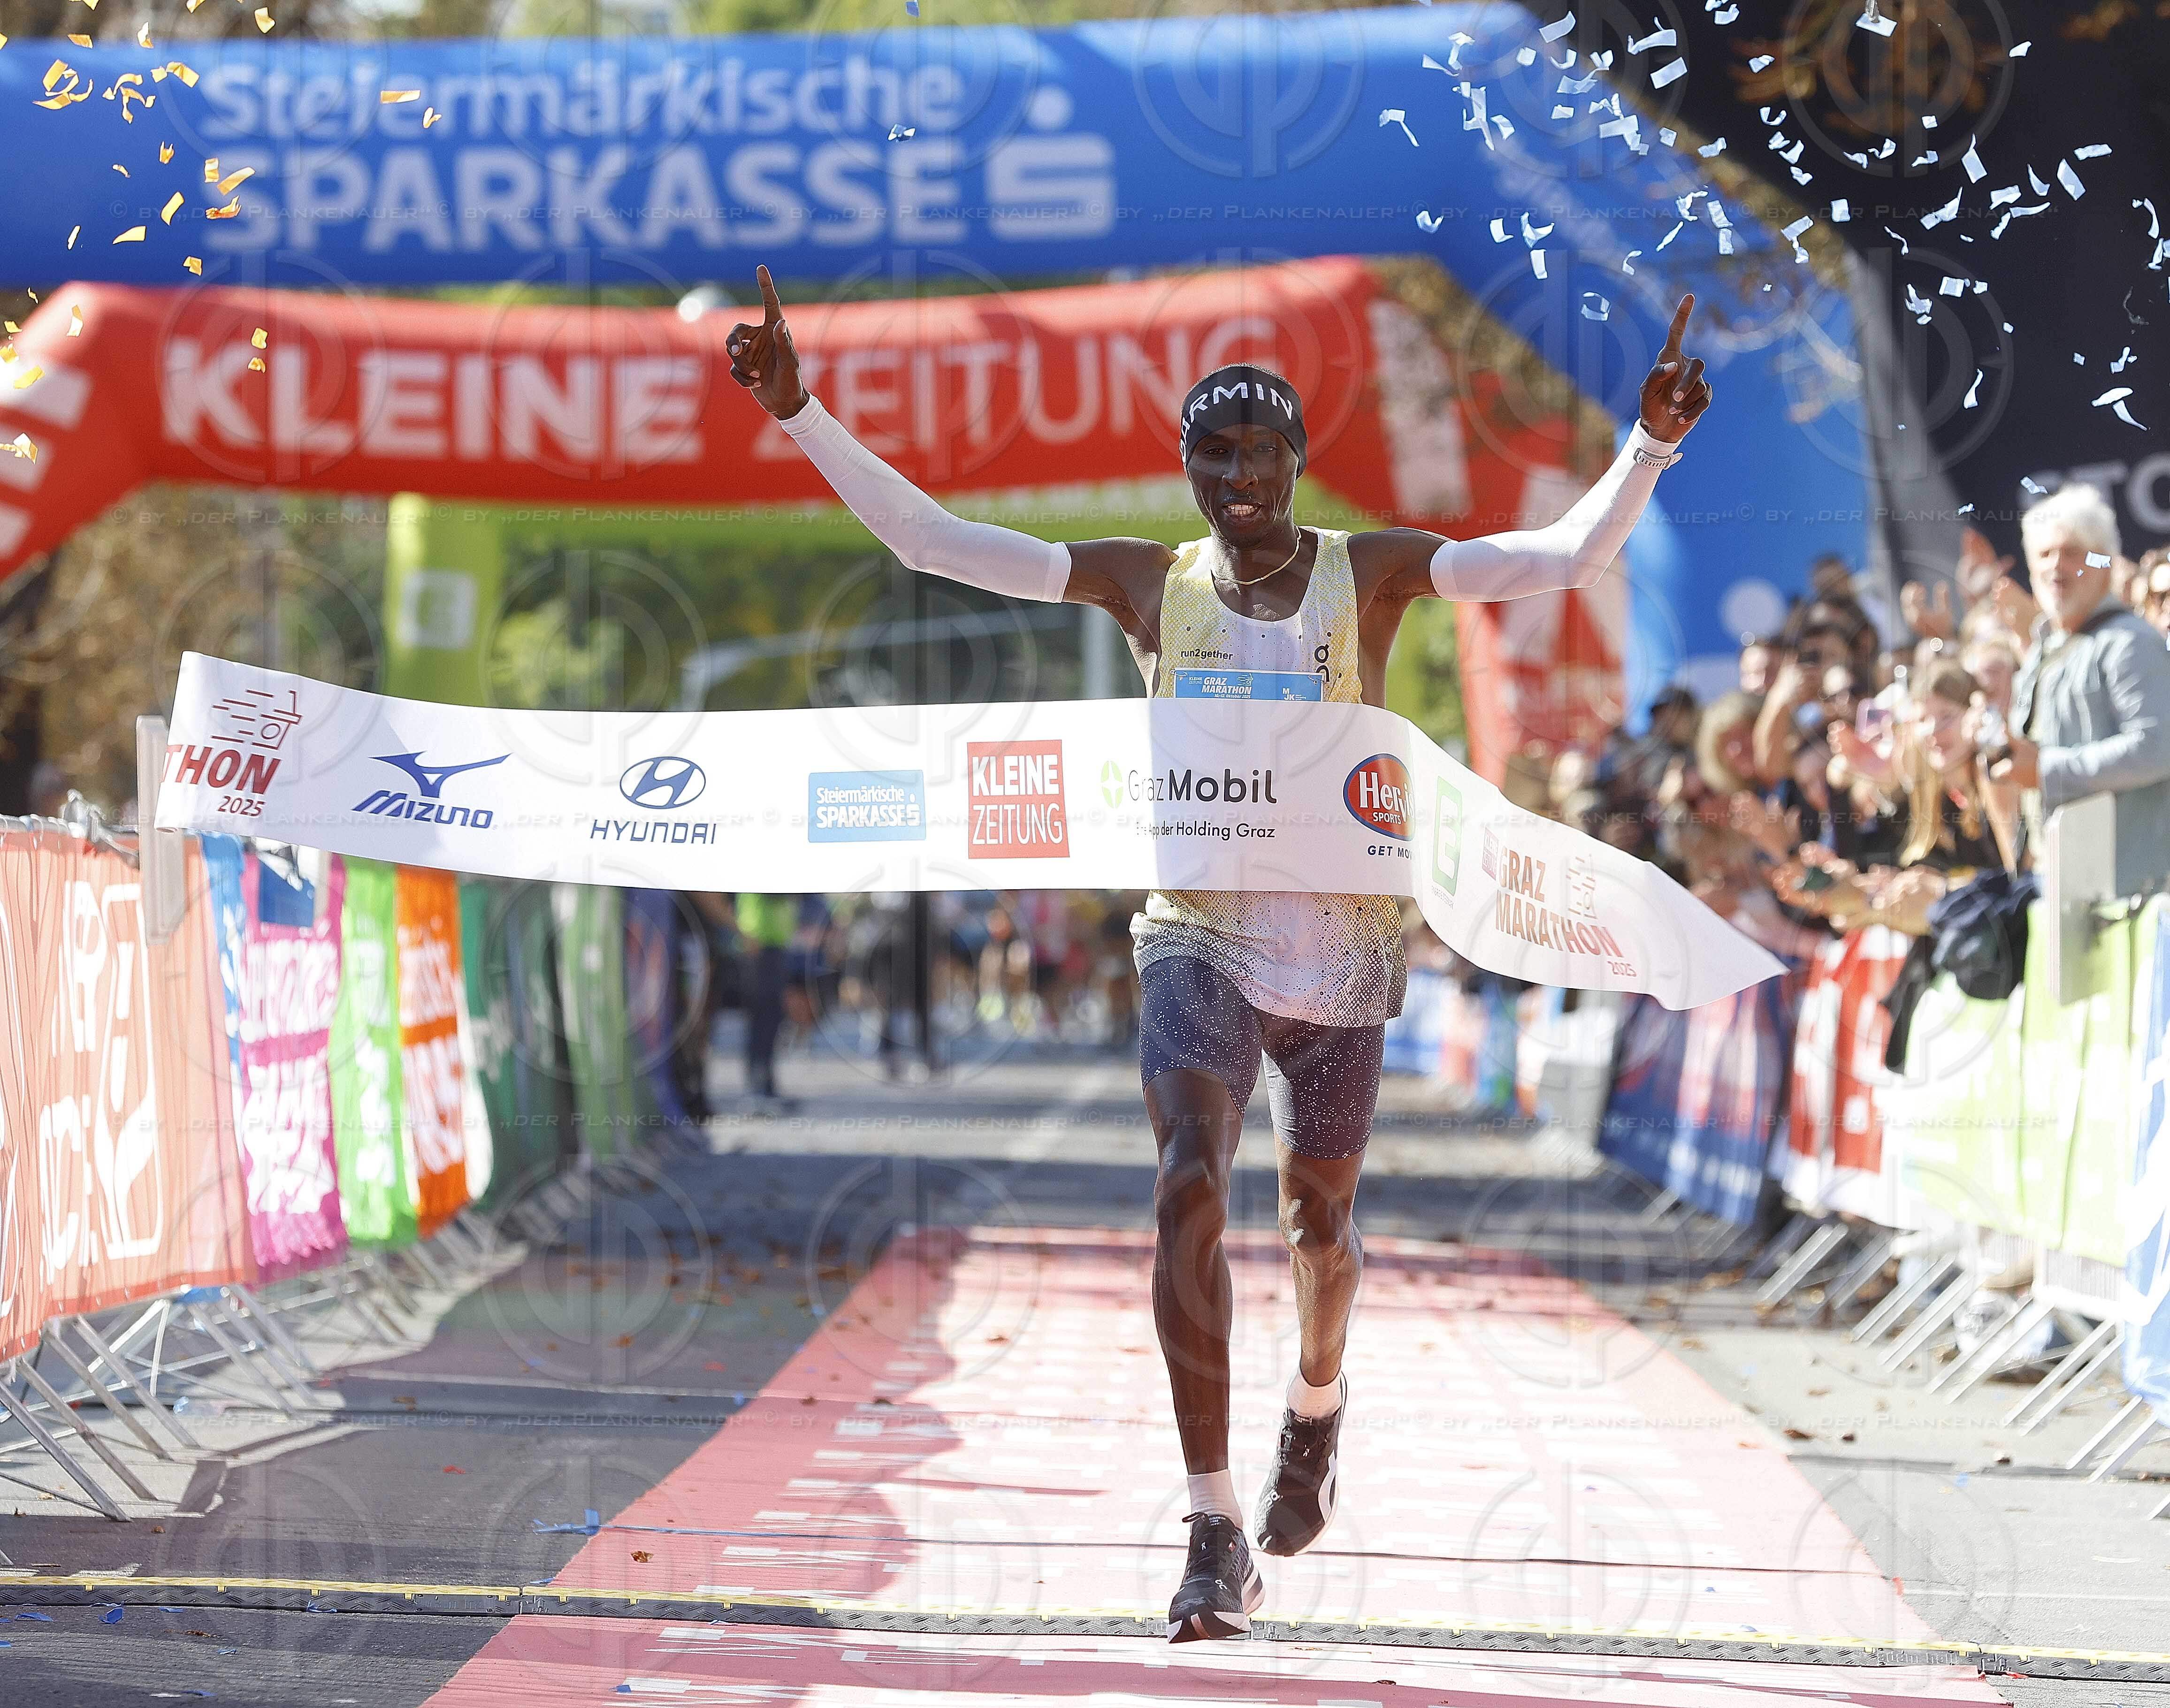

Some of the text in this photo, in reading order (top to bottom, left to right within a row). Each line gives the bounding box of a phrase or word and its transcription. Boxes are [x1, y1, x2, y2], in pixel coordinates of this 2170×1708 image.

[202, 59, 966, 141] Steiermärkische
[202, 143, 968, 256] SPARKASSE
[162, 336, 706, 465] KLEINE
[1180, 648, 1233, 660] run2gether
[1201, 685, 1252, 694] MARATHON
[1204, 677, 1228, 686] GRAZ
[971, 754, 1060, 796] KLEINE
[217, 796, 266, 816] 2025
[816, 785, 905, 804] Steiermärkische
[1359, 771, 1414, 822] Hervis
[816, 805, 906, 829] SPARKASSE
[971, 804, 1063, 846] ZEITUNG
[1373, 812, 1401, 825] SPORTS
[590, 820, 717, 845] HYUNDAI
[1161, 821, 1174, 836] der
[1177, 820, 1230, 840] Holding
[1236, 823, 1276, 838] Graz
[1368, 845, 1393, 856] GET
[1499, 847, 1546, 902] GRAZ
[1495, 890, 1624, 958] MARATHON
[1607, 961, 1636, 977] 2025
